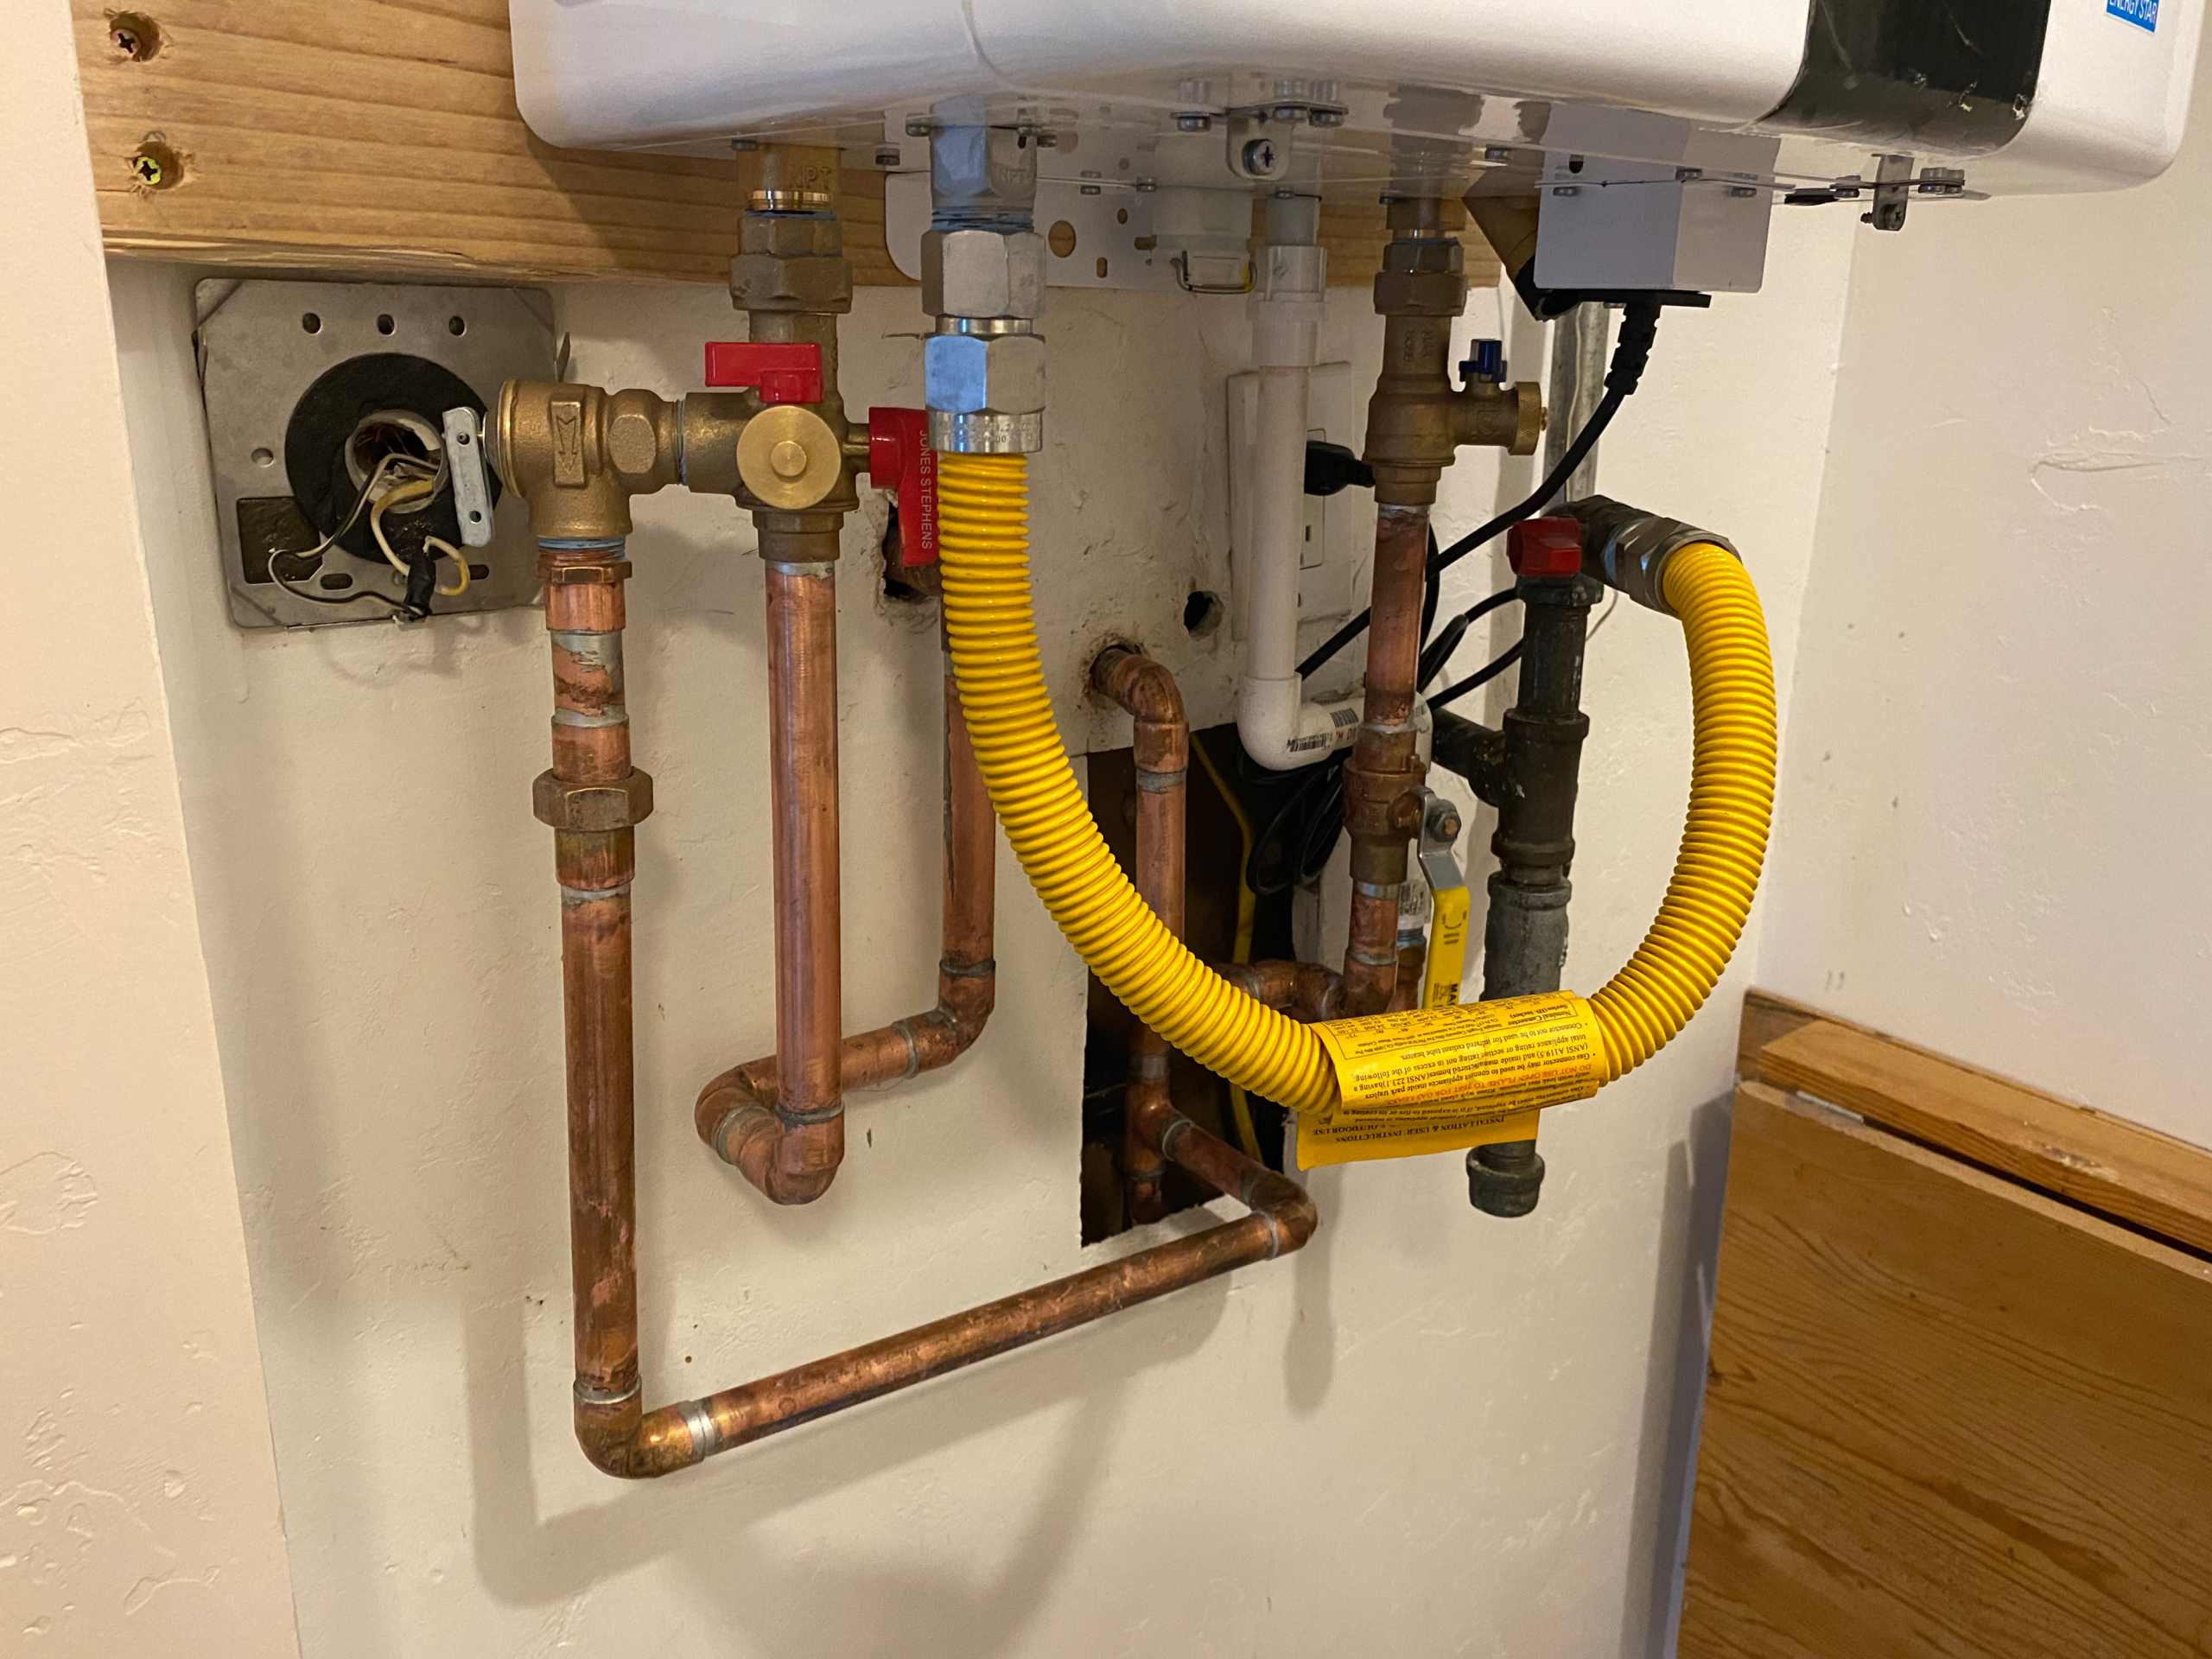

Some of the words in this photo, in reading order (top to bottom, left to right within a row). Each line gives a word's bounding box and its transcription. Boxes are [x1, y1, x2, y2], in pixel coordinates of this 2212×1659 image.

[2139, 0, 2158, 24] STAR
[919, 430, 931, 474] JONES
[920, 478, 932, 550] STEPHENS
[1542, 1010, 1571, 1020] Nominal
[1508, 1015, 1542, 1026] Connector
[1548, 1023, 1582, 1033] Connector
[1466, 1040, 1491, 1049] infrared
[1536, 1036, 1568, 1047] appliance
[1441, 1045, 1465, 1055] radiant
[1515, 1043, 1535, 1052] rating
[1566, 1042, 1588, 1052] (ANSI
[1481, 1049, 1503, 1058] section
[1543, 1056, 1575, 1065] connector
[1452, 1058, 1498, 1076] manufactured
[1465, 1070, 1490, 1080] connect
[1517, 1073, 1541, 1082] OPEN
[1428, 1075, 1463, 1087] appliances
[1488, 1077, 1516, 1087] FLAME
[1391, 1086, 1405, 1096] park
[1453, 1083, 1471, 1092] TEST
[1535, 1090, 1568, 1100] connector
[1475, 1102, 1505, 1111] replaced,
[1332, 1124, 1377, 1133] OUTDOOR
[1441, 1117, 1503, 1131] INSTALLATION
[1335, 1130, 1402, 1143] INSTRUCTIONS
